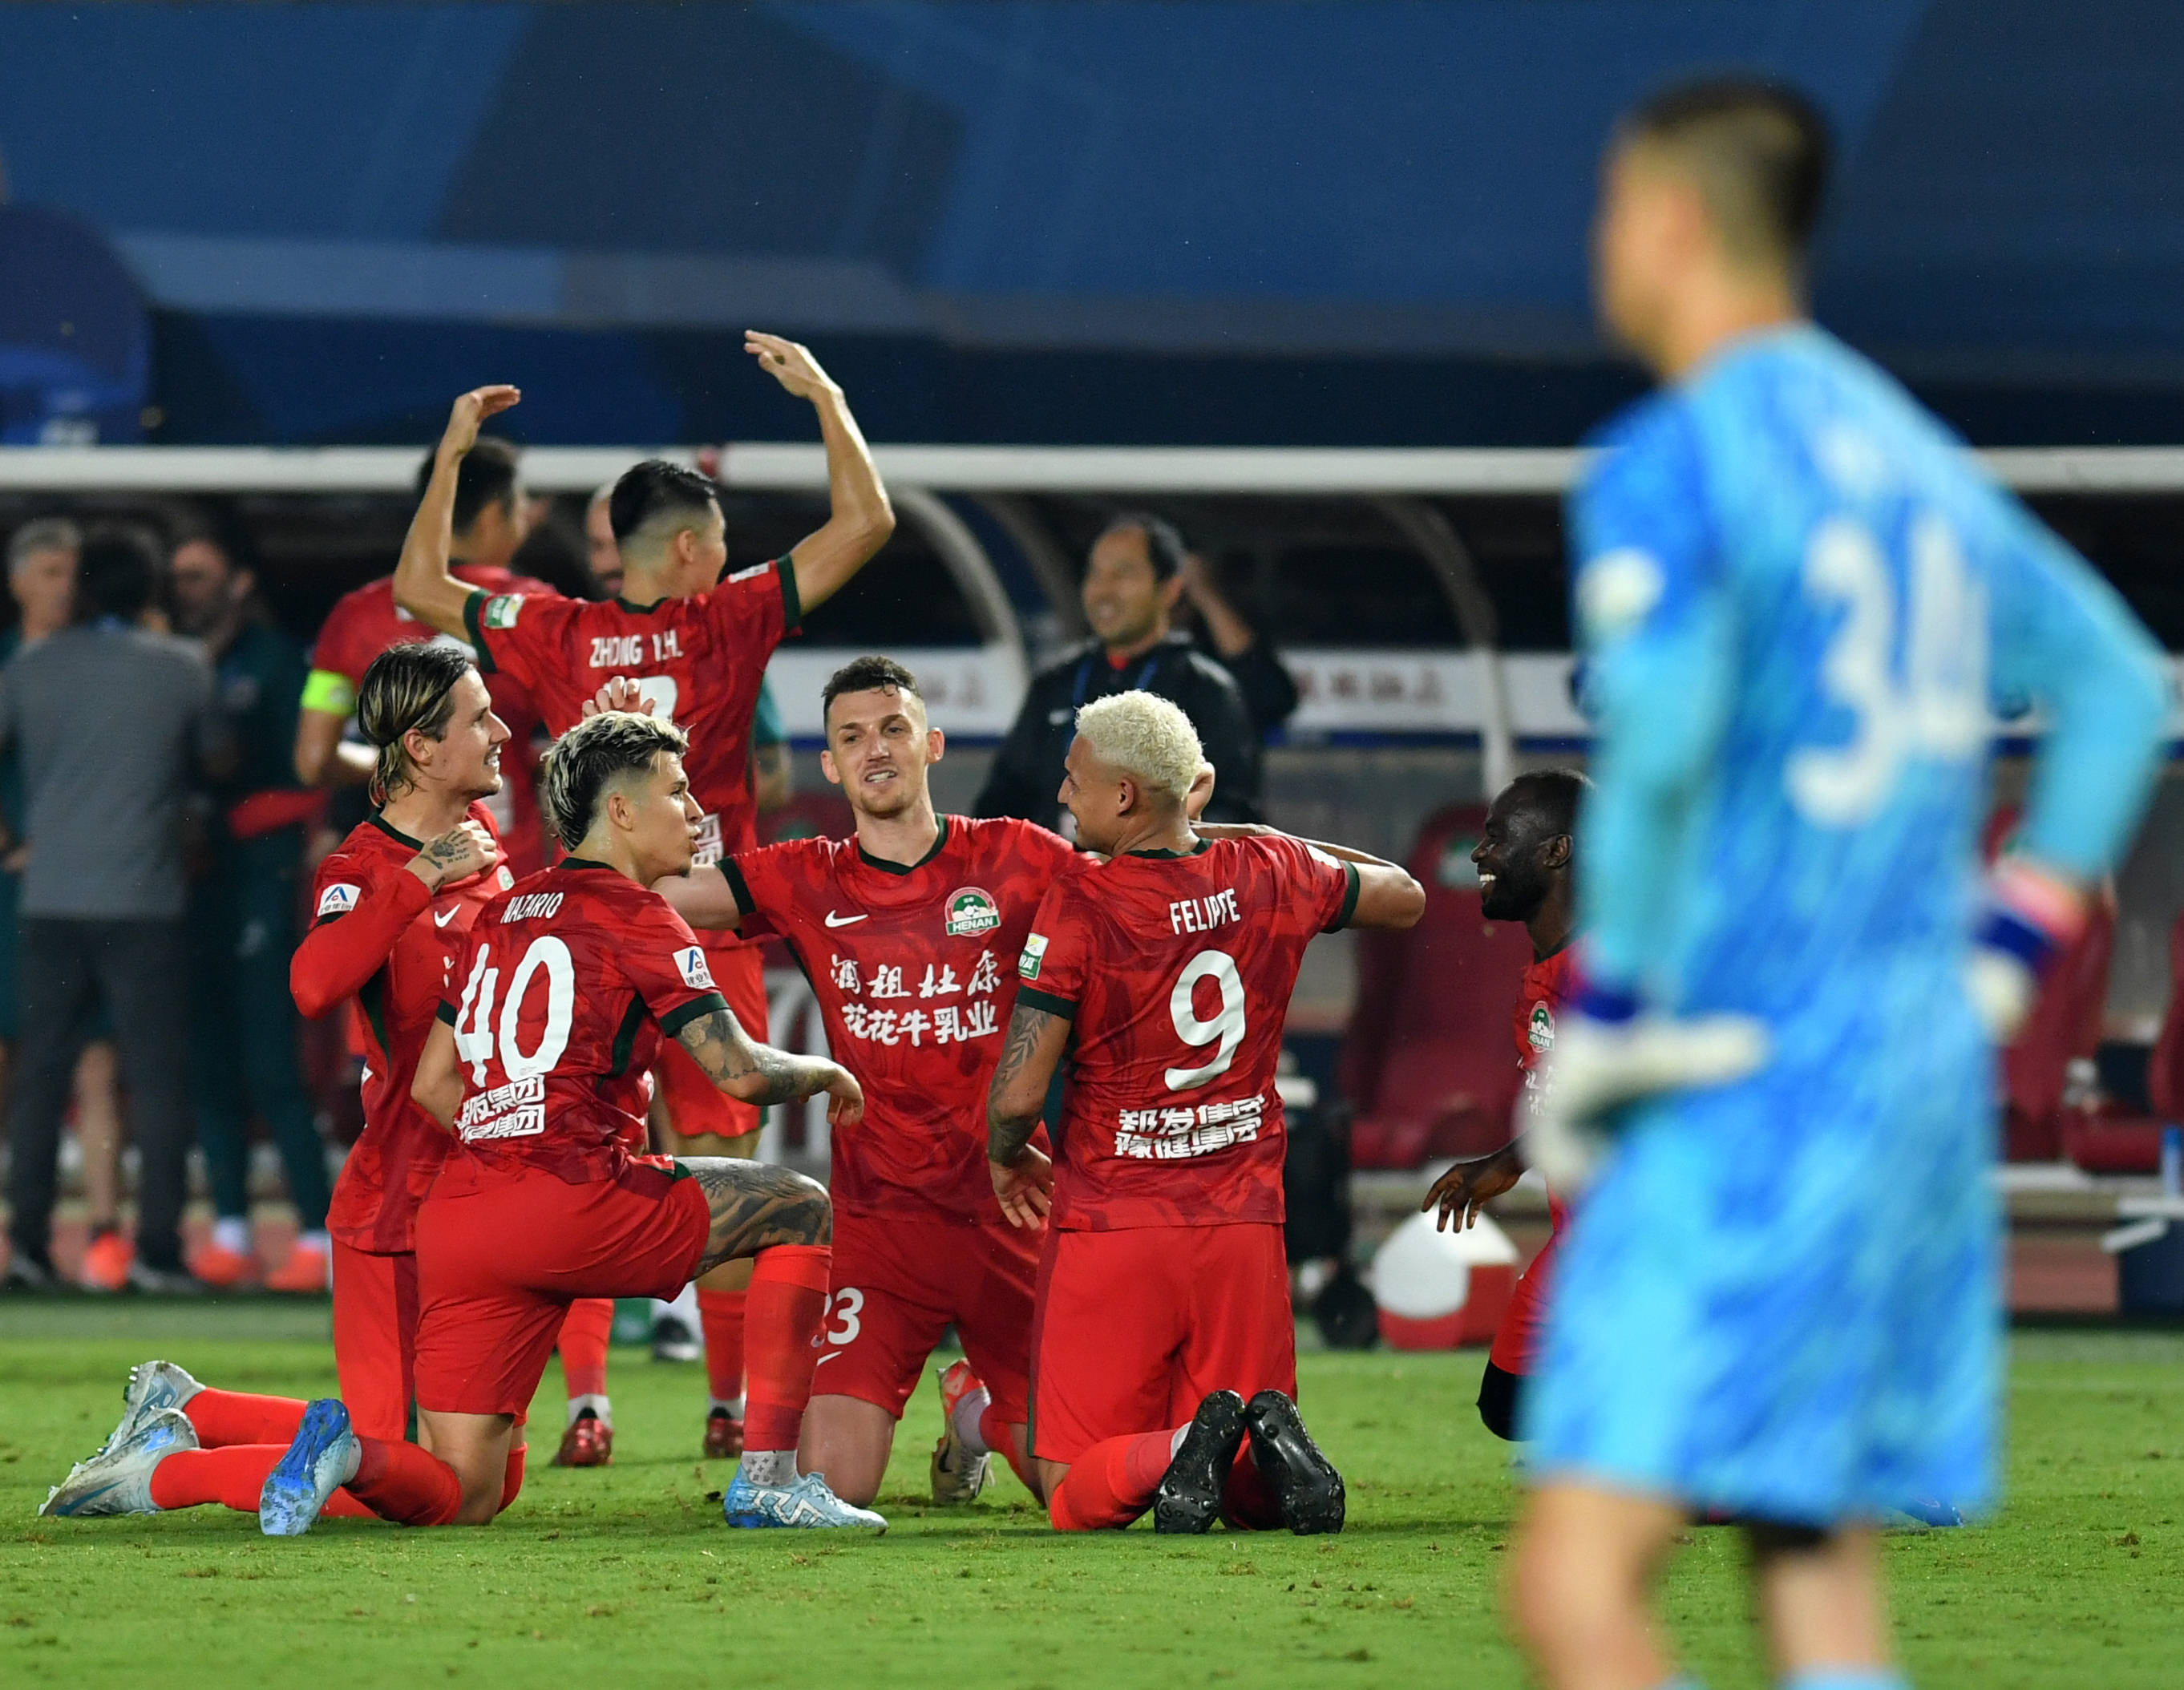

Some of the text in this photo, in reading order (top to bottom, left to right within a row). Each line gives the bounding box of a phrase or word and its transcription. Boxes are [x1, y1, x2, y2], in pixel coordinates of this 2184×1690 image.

[588, 634, 643, 669] ZHONG
[499, 891, 564, 924] NAZARIO
[952, 916, 993, 932] HENAN
[1169, 887, 1241, 936] FELIPPE
[830, 949, 1001, 998] 酒祖杜康
[453, 936, 575, 1088] 40
[841, 1000, 999, 1047] 花花牛乳业
[1164, 949, 1246, 1091] 9
[823, 1287, 864, 1345] 3
